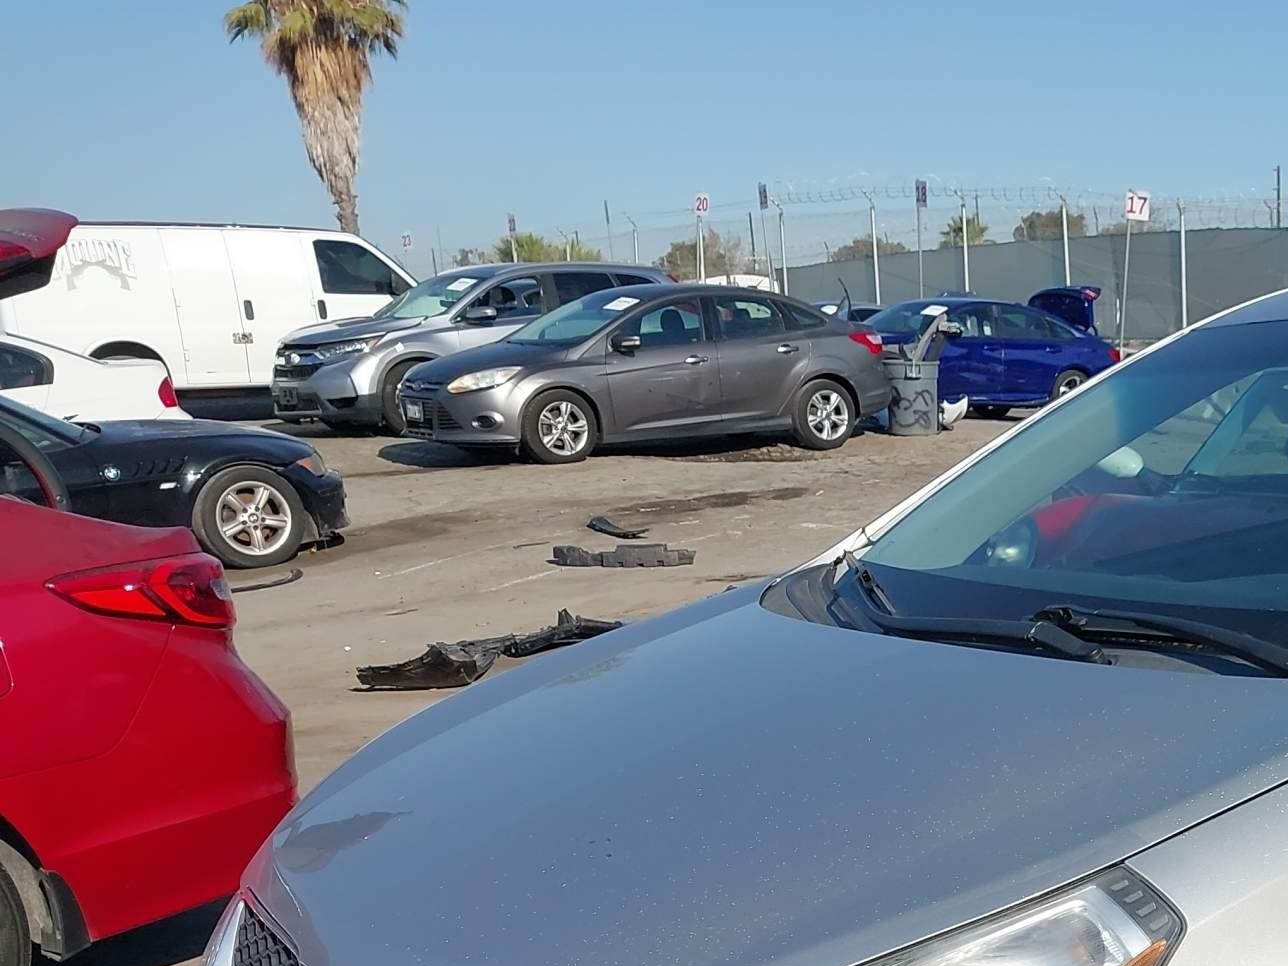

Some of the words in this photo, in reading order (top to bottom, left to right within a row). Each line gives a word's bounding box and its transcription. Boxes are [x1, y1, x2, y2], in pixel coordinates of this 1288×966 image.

[915, 186, 927, 202] 18
[696, 197, 708, 211] 20
[1127, 196, 1148, 215] 17
[401, 234, 412, 247] 23
